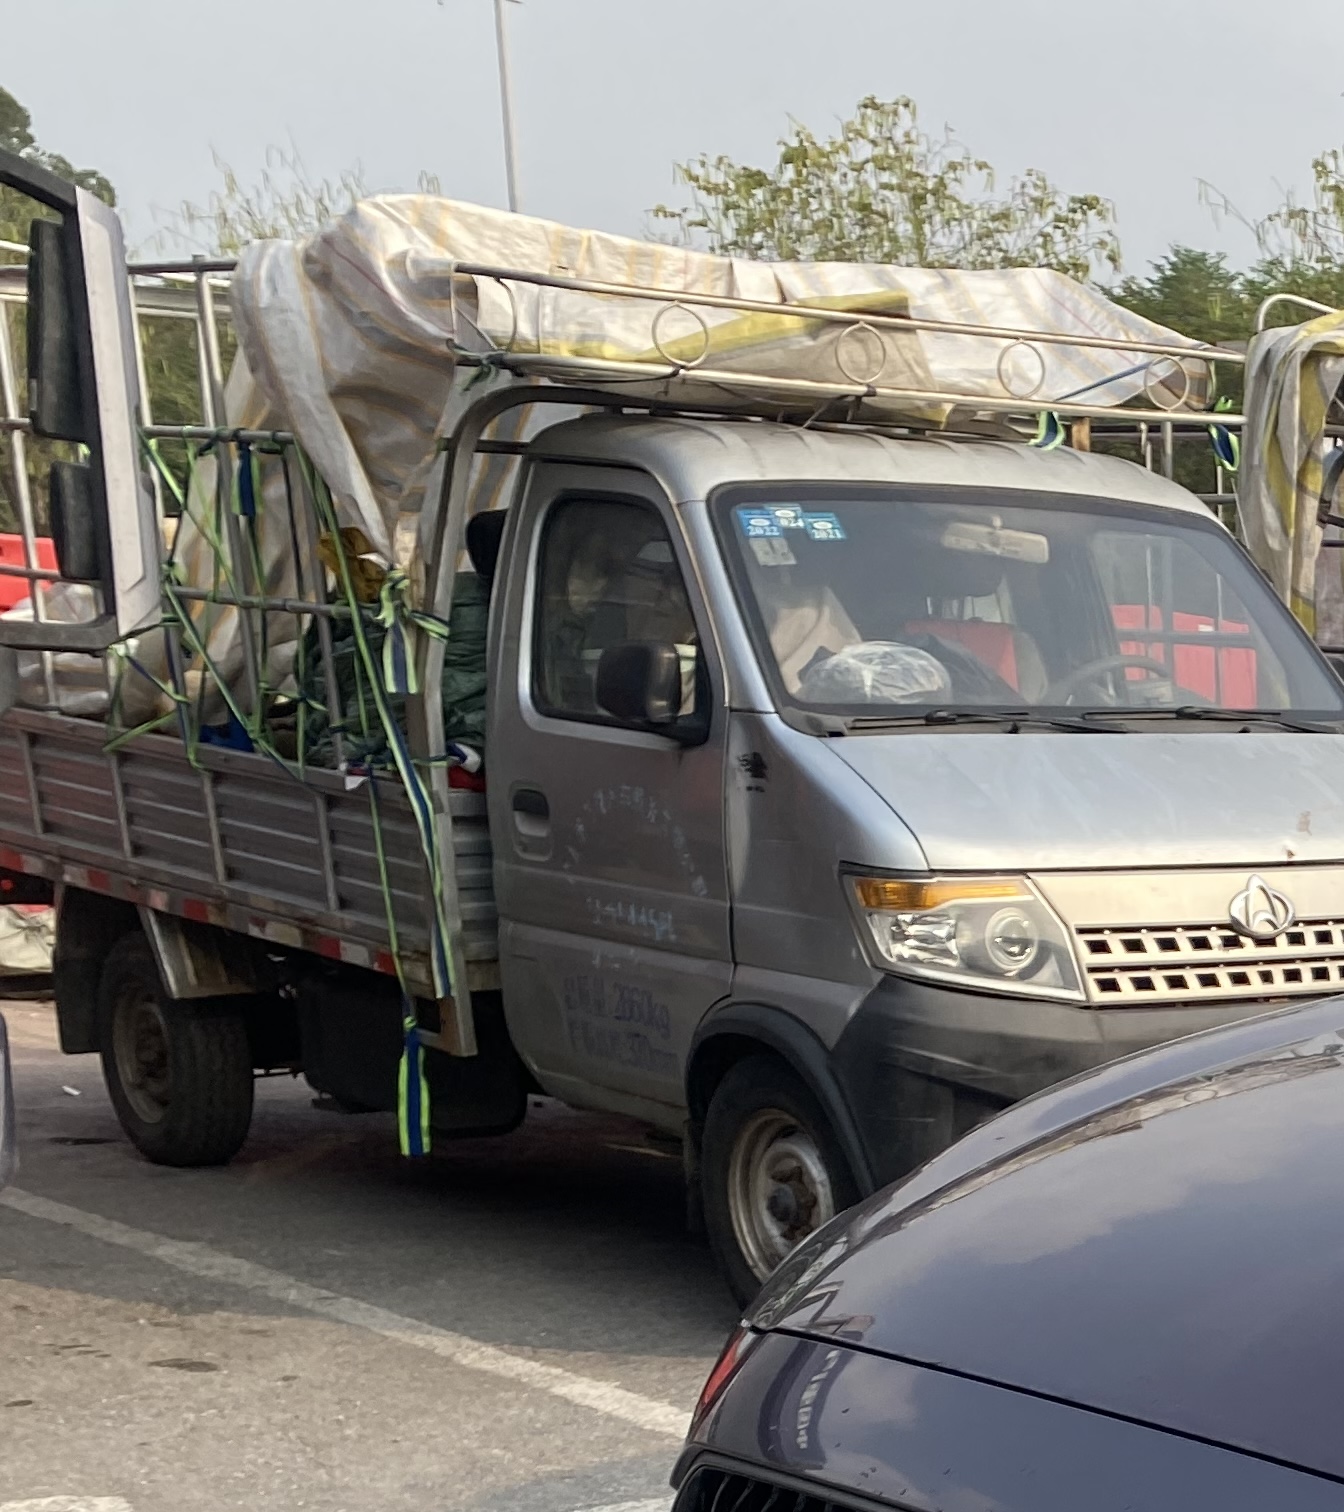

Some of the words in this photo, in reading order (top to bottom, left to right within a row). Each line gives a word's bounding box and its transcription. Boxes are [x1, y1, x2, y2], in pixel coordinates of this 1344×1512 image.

[779, 518, 805, 527] 024
[747, 526, 780, 536] 2022
[812, 529, 843, 539] 2021
